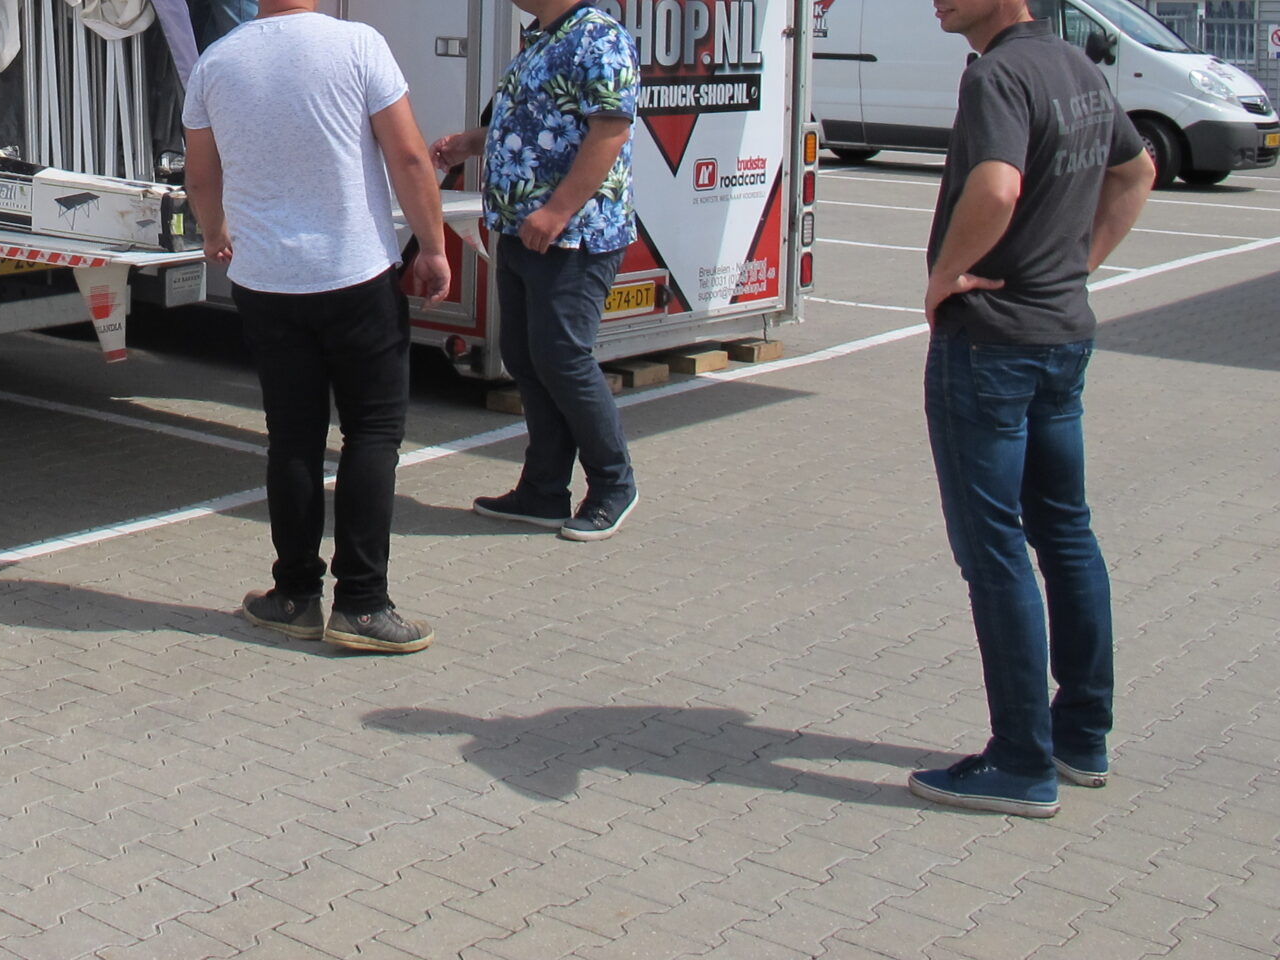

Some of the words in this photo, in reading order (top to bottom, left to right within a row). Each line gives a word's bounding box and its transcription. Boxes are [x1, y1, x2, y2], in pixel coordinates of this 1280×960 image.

[638, 82, 750, 109] W.TRUCK-SHOP.NL
[720, 170, 767, 188] roadcard
[604, 287, 651, 311] G-74-DT
